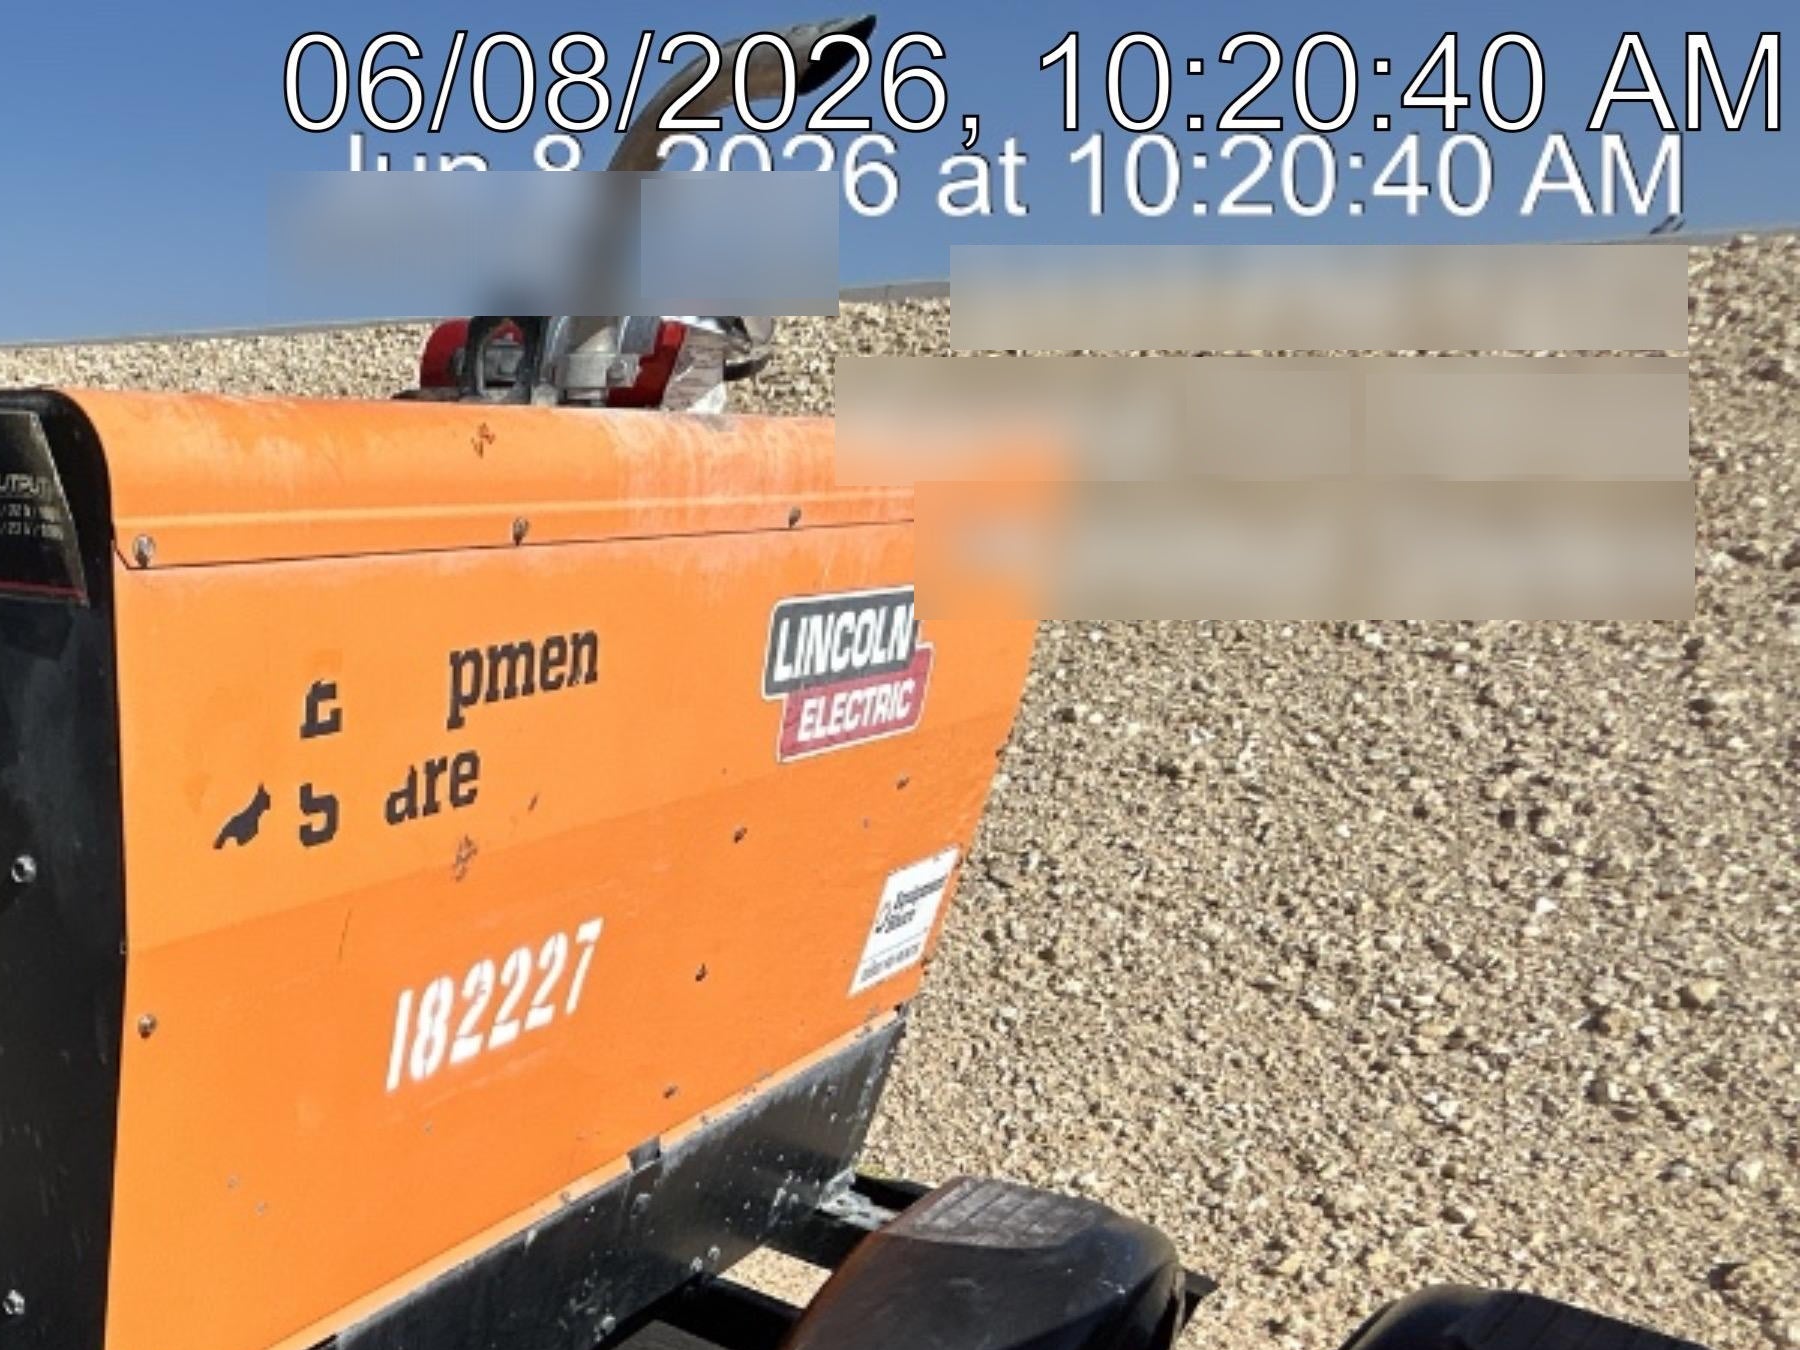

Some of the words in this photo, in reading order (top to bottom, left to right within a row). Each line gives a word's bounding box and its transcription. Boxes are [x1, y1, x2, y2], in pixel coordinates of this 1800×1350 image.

[773, 602, 915, 682] LINCOLN
[797, 677, 916, 742] ELECTRIC
[385, 916, 605, 1093] 182227
